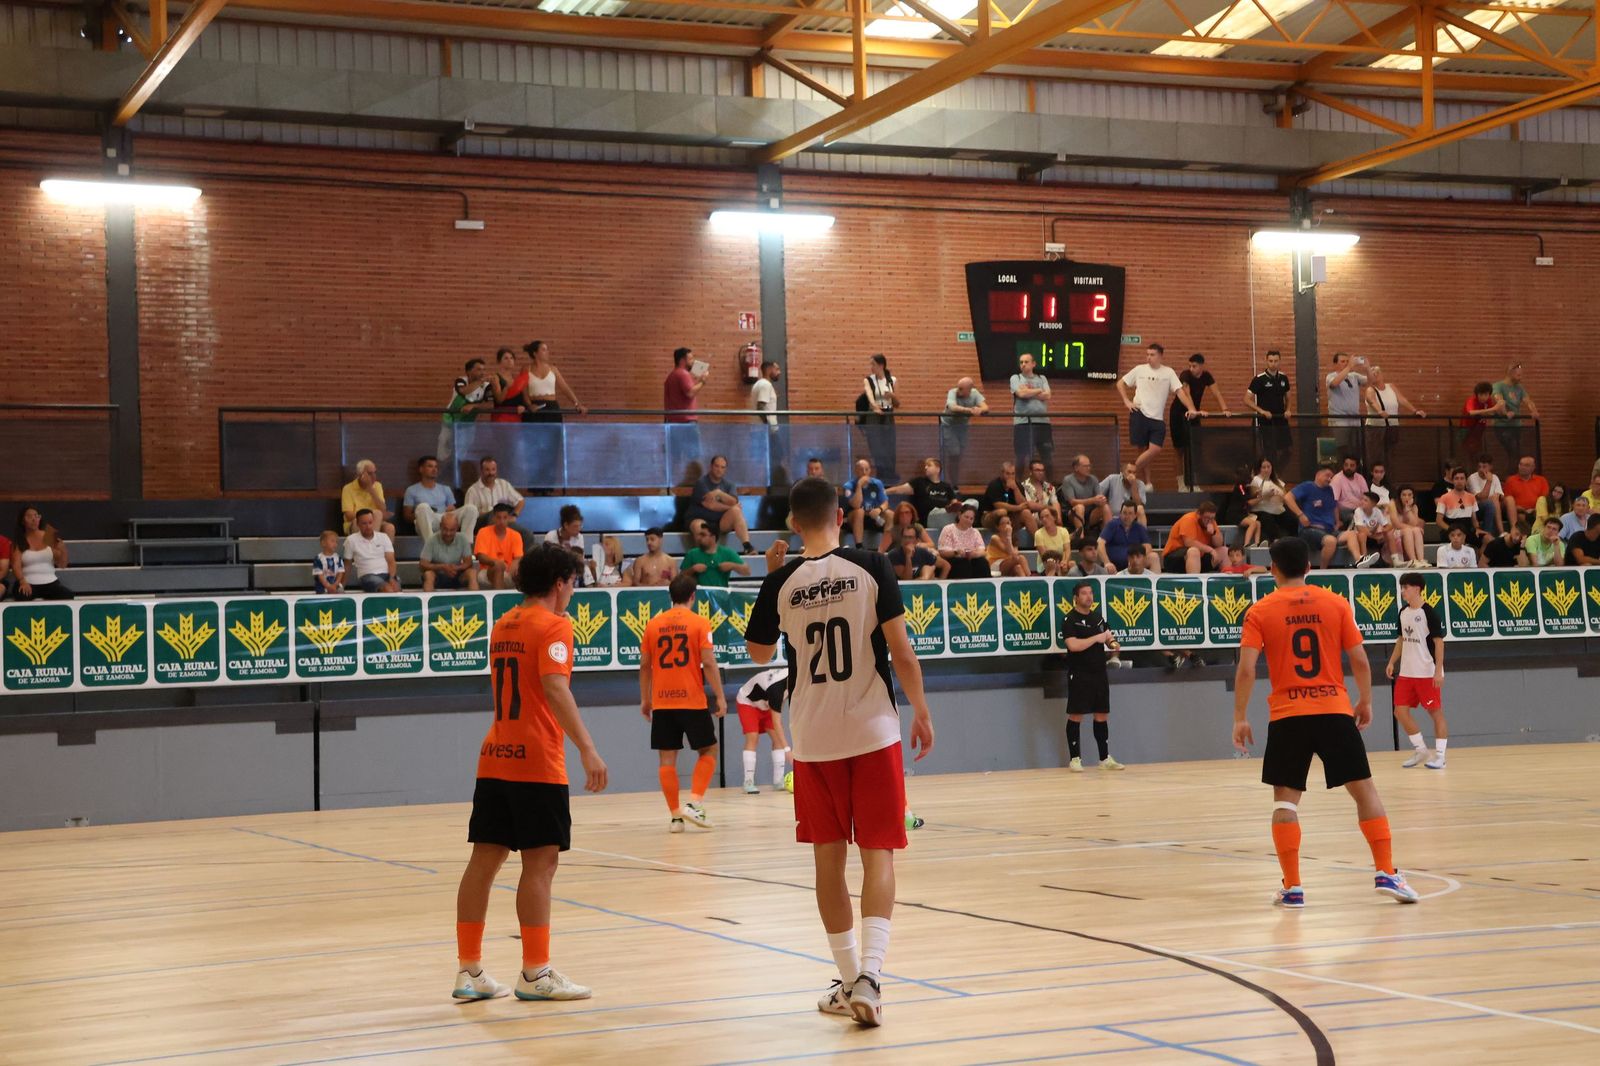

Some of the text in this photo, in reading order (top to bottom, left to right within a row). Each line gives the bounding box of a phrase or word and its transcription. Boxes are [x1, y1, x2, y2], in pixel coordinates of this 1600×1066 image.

[998, 275, 1017, 283] LOCAL
[1074, 277, 1104, 285] VISITANTE
[1023, 294, 1027, 319] 1
[1051, 297, 1055, 317] 1
[1093, 294, 1107, 322] 2
[1042, 342, 1084, 368] 1:17
[1092, 372, 1117, 380] MONDO
[1285, 614, 1322, 625] SAMUEL
[1517, 618, 1538, 626] RURAL
[1563, 617, 1584, 625] RURAL
[1129, 628, 1152, 636] RURAL
[1161, 627, 1178, 635] CAJA
[917, 636, 943, 645] RURAL
[951, 636, 970, 644] CAJA
[1005, 633, 1023, 641] CAJA
[1025, 632, 1049, 640] RURAL
[582, 647, 610, 656] RURAL
[657, 633, 690, 669] 23
[806, 617, 853, 684] 20
[1292, 628, 1321, 679] 9
[298, 656, 355, 666] CAJA RURAL
[366, 653, 421, 663] CAJA RURAL
[432, 651, 486, 661] CAJA RURAL
[157, 661, 217, 671] CAJA RURAL
[229, 659, 287, 669] CAJA RURAL
[7, 667, 71, 678] CAJA RURAL
[83, 664, 145, 675] CAJA RURAL
[493, 657, 521, 721] 11
[658, 689, 688, 698] uvesa
[1288, 685, 1338, 700] uvesa
